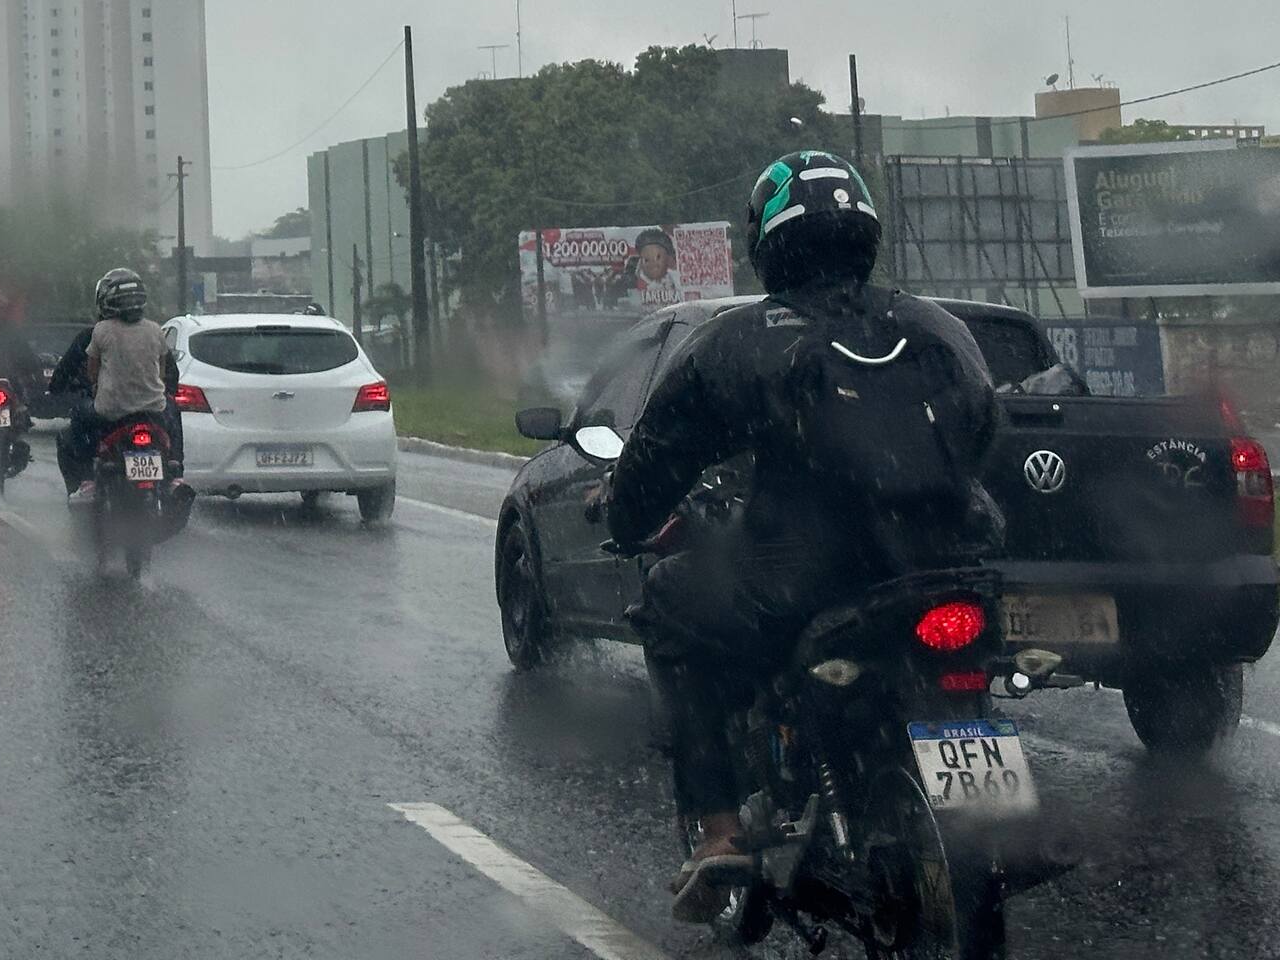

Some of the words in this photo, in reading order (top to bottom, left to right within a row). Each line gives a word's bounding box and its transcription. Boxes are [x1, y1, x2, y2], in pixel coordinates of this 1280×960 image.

[1095, 166, 1176, 191] Aluguel
[943, 727, 984, 738] BRASIL
[938, 738, 1004, 769] QFN
